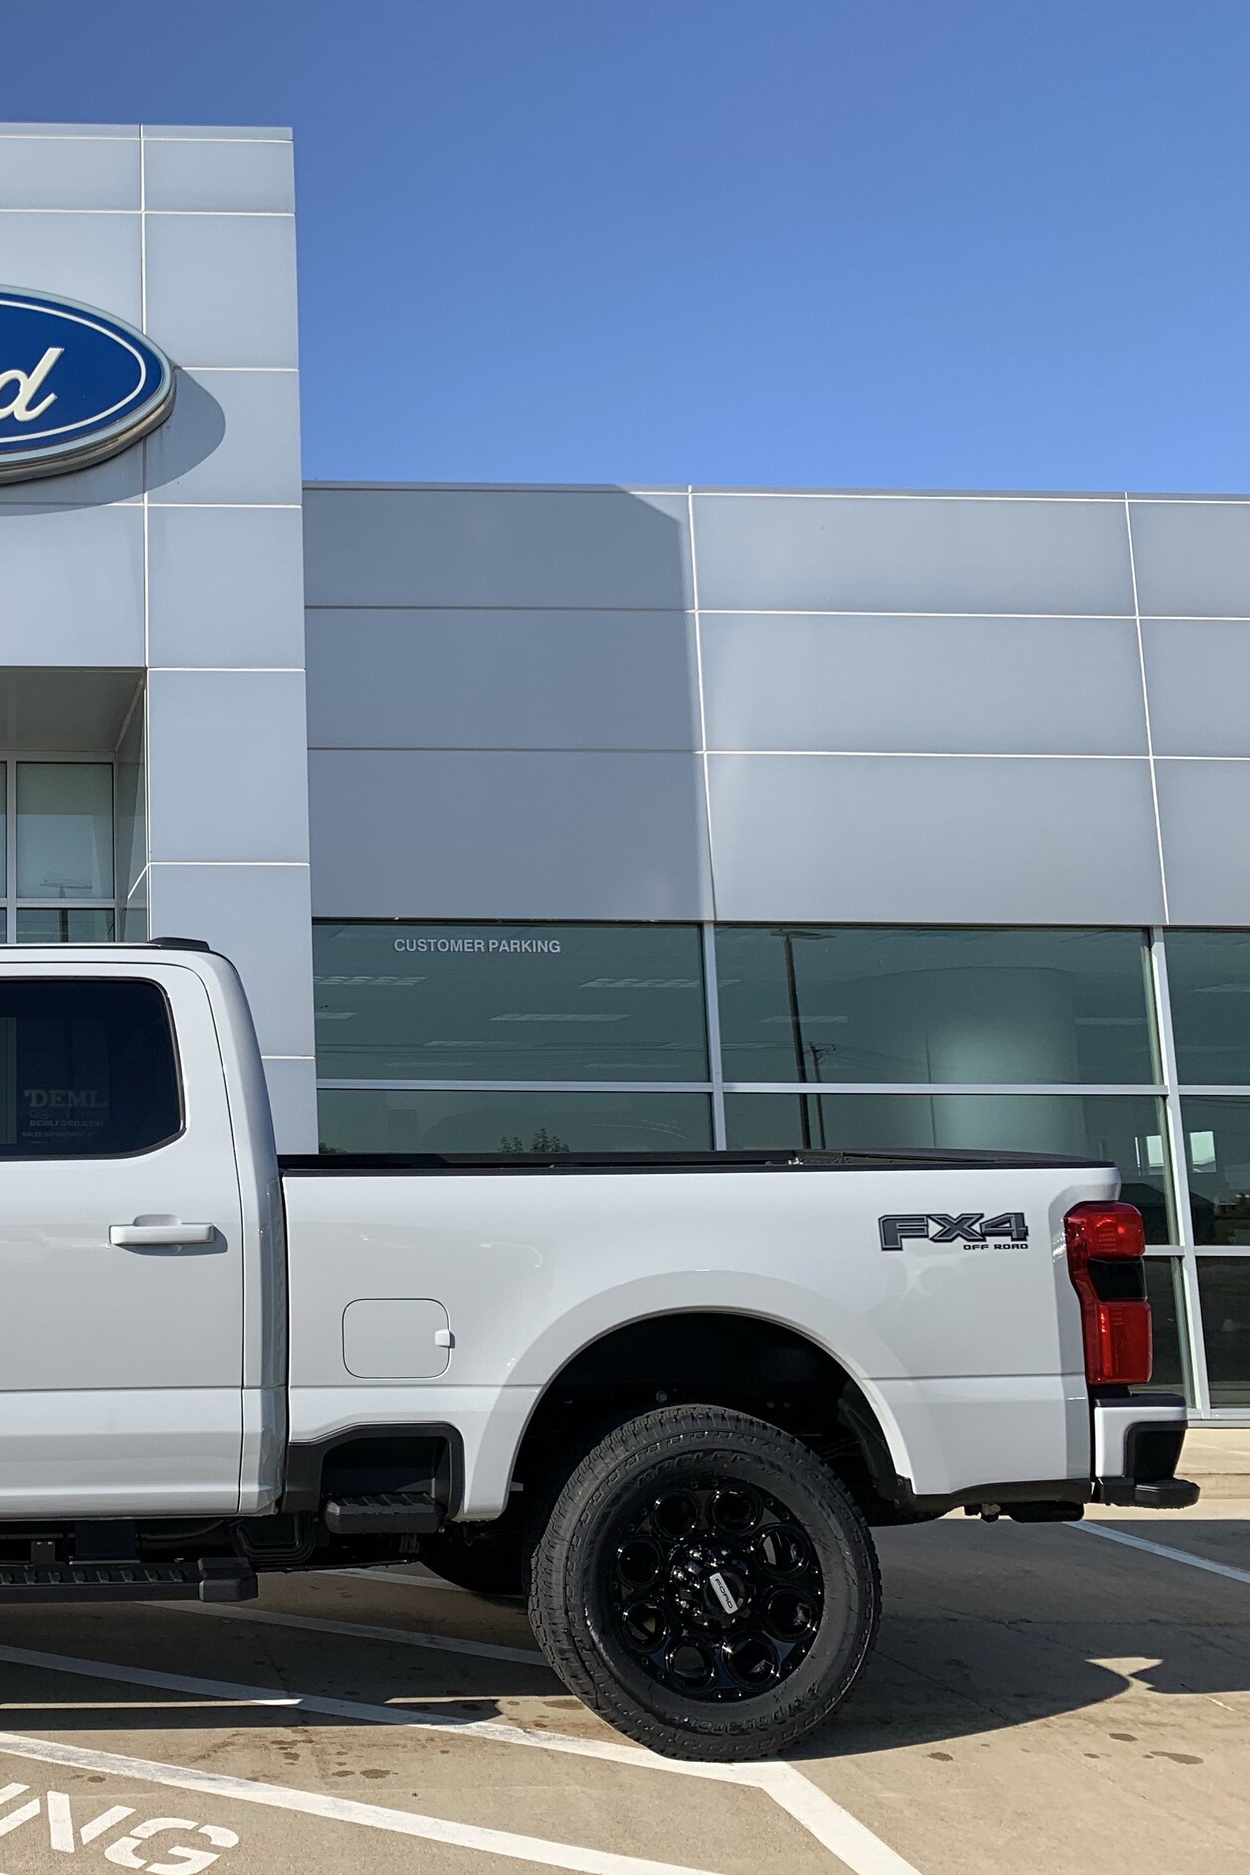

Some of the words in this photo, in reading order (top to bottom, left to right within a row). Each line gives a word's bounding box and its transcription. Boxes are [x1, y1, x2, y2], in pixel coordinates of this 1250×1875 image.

[394, 938, 485, 952] CUSTOMER
[488, 939, 561, 953] PARKING
[23, 1088, 109, 1108] DEML
[878, 1213, 1029, 1251] FX4
[715, 1578, 733, 1609] FORD
